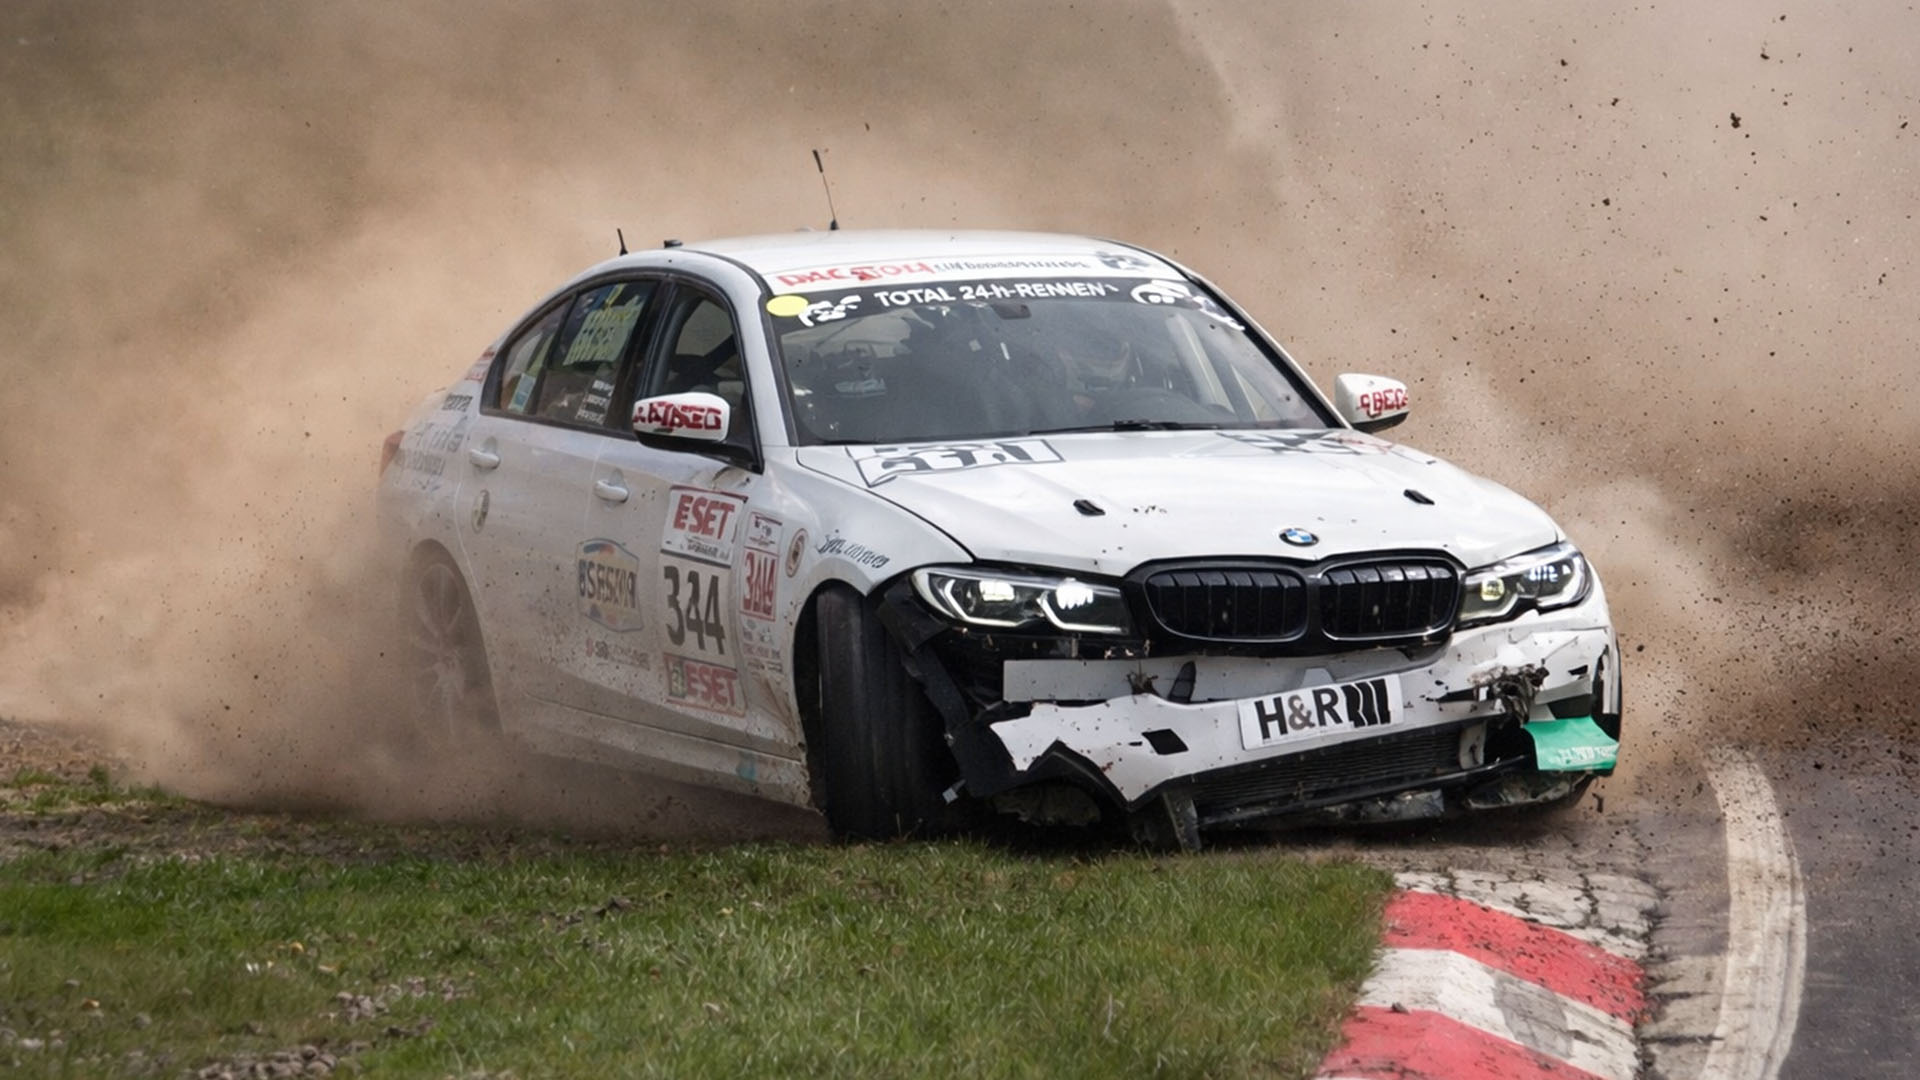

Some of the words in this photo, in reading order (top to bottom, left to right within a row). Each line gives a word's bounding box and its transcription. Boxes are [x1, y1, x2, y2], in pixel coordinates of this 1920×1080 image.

[874, 287, 956, 307] TOTAL
[673, 494, 735, 540] ESET
[664, 565, 726, 656] 344
[686, 663, 737, 707] ESET
[1254, 687, 1343, 740] H&R
